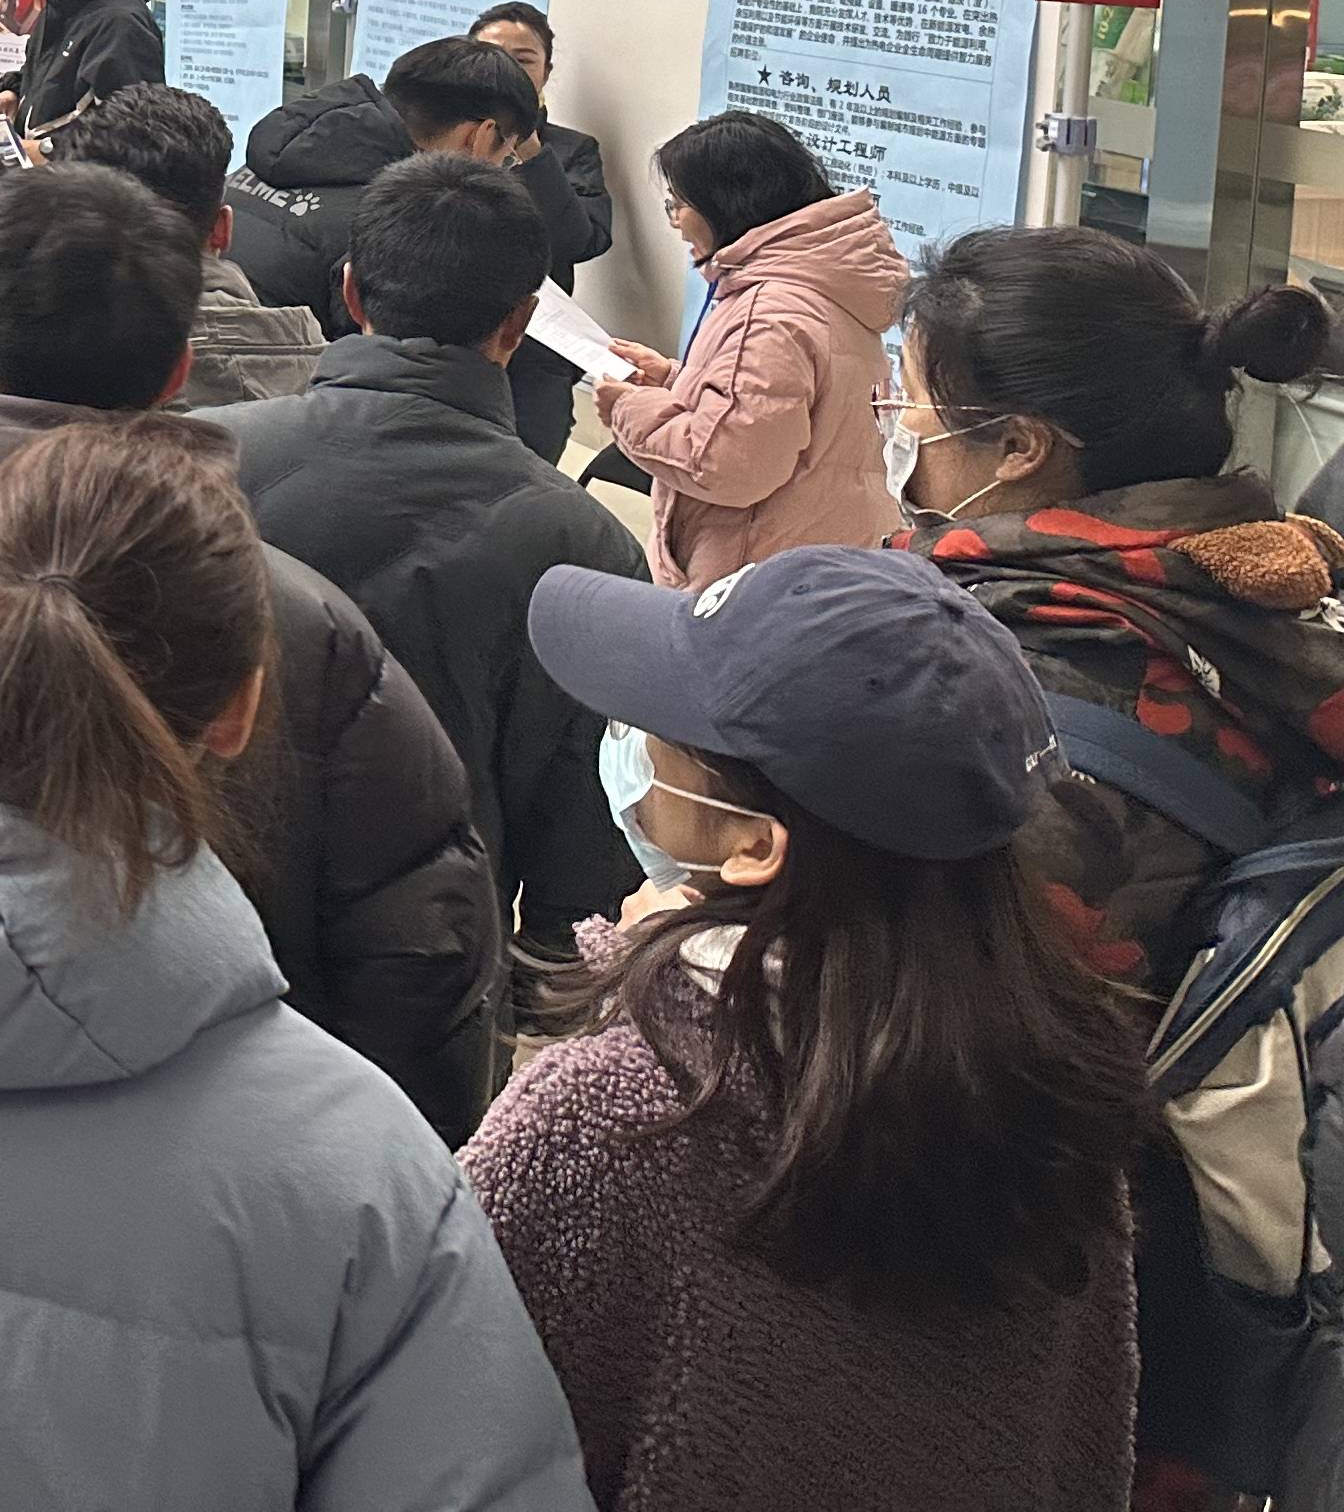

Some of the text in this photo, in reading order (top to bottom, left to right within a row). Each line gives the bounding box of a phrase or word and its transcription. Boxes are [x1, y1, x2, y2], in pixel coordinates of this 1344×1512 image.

[779, 70, 891, 103] 咨询、规划人员
